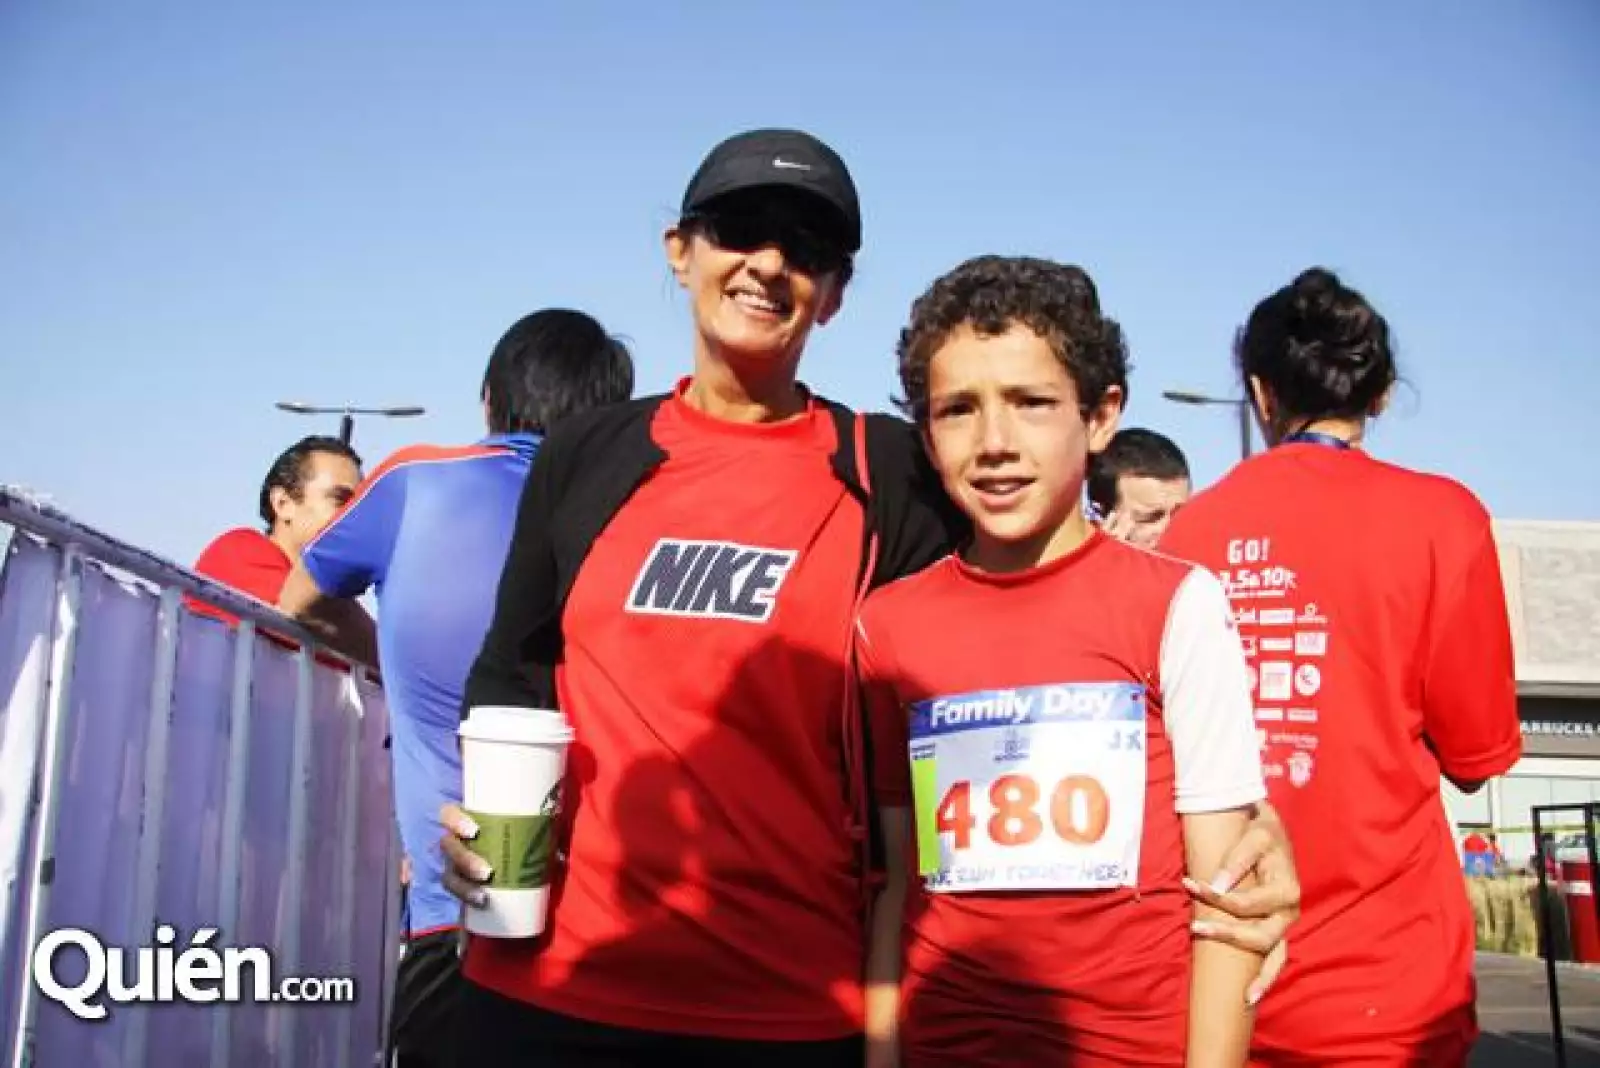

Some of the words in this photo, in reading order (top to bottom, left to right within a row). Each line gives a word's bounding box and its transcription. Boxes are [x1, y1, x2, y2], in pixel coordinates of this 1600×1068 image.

[1226, 536, 1270, 565] GO!
[630, 541, 794, 620] NIKE
[930, 689, 1034, 728] Family
[1042, 686, 1117, 719] Day
[935, 773, 1111, 850] 480
